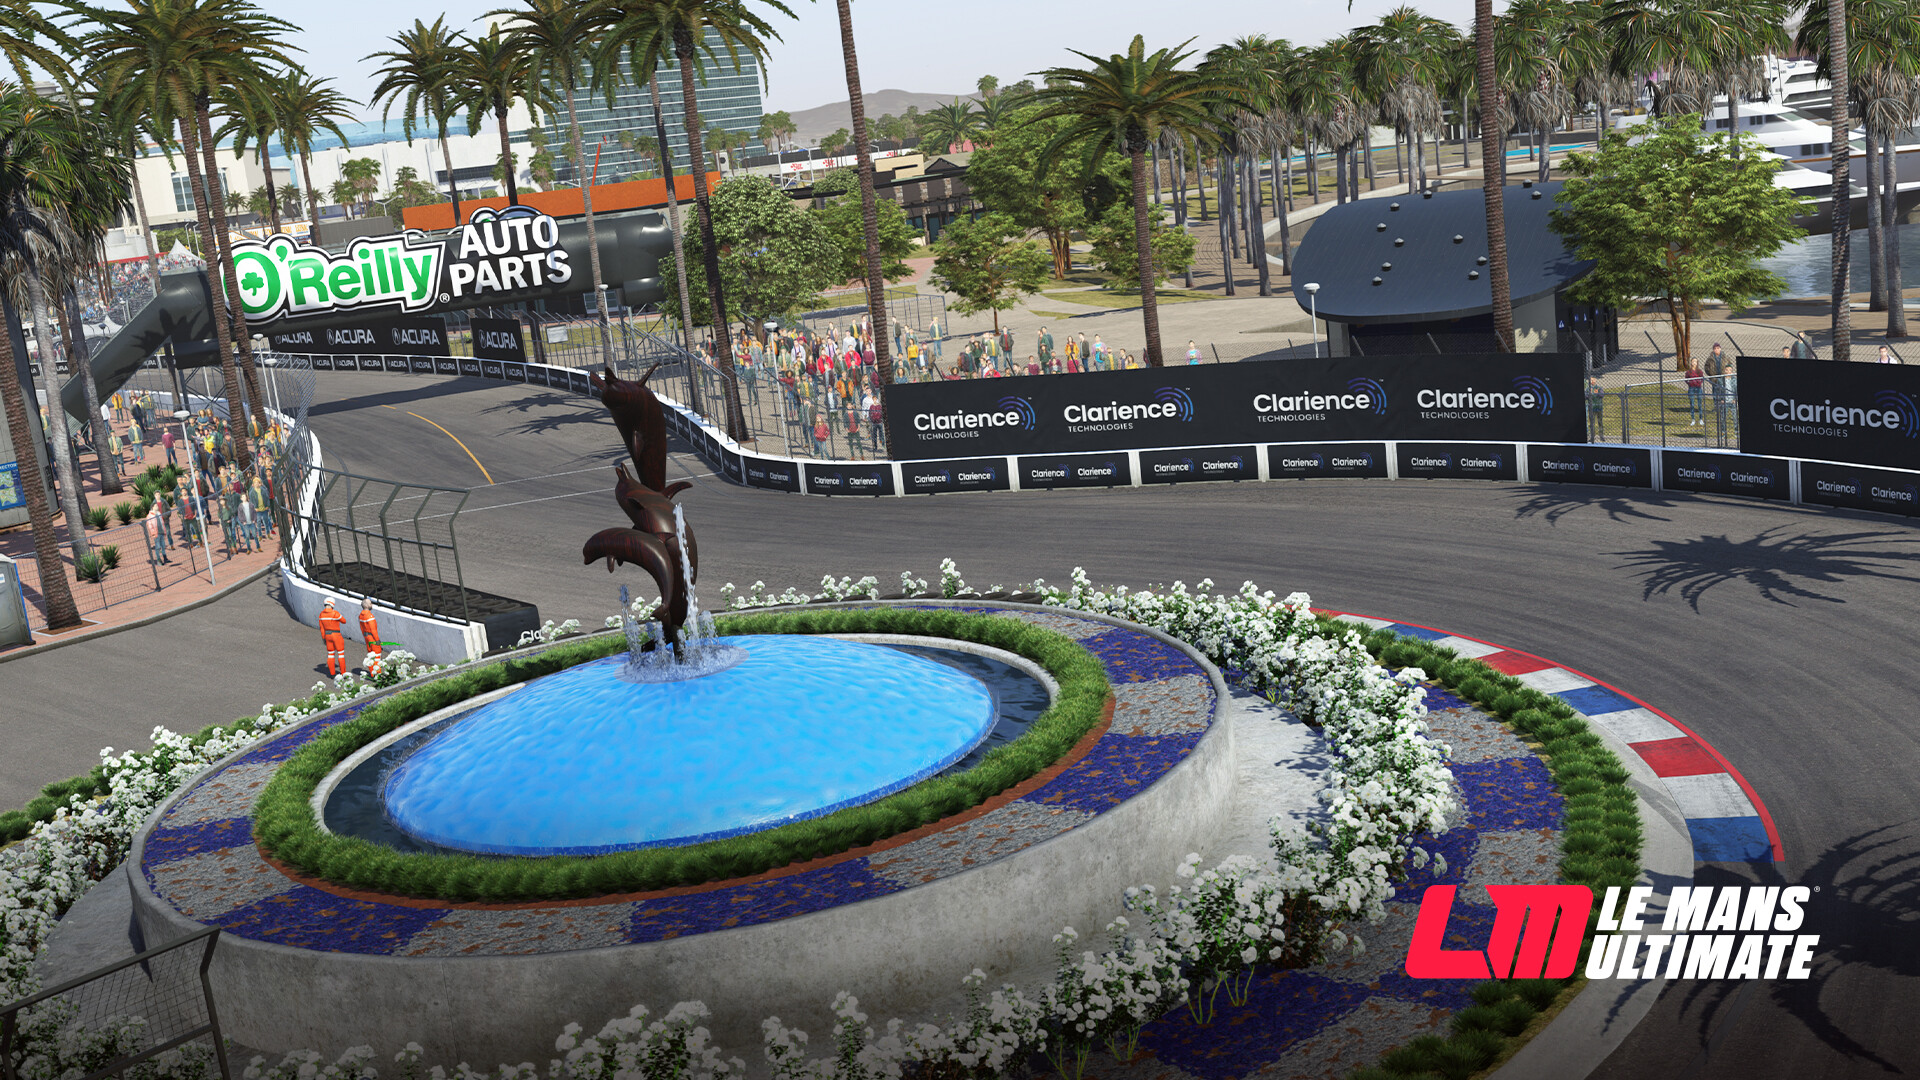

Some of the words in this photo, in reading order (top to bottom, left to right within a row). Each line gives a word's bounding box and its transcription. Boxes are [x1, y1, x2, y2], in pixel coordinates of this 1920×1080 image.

[460, 215, 559, 259] AUTO
[450, 250, 572, 297] PARTS
[223, 246, 434, 314] O'Reilly
[334, 329, 376, 344] ACURA
[401, 328, 440, 345] ACURA
[486, 331, 518, 350] ACURA
[464, 364, 480, 372] ACURA
[1253, 390, 1370, 412] Clarience
[1416, 387, 1536, 410] Clarience
[1064, 401, 1177, 424] Clarience
[1257, 413, 1326, 422] TECHNOLOGIES
[1420, 411, 1490, 419] TECHNOLOGIES
[1770, 398, 1900, 429] Clarience
[914, 410, 1020, 432] Clarience
[1068, 422, 1133, 433] TECHNOLOGIES
[1773, 424, 1848, 438] TECHNOLOGIES
[918, 430, 979, 440] TECHNOLOGIES
[1202, 460, 1238, 470] Clarience
[1282, 458, 1318, 467] Clarience
[1332, 457, 1367, 466] Clarience
[1411, 457, 1447, 466] Clarience
[1460, 458, 1497, 467] Clarience
[1542, 460, 1579, 470] Clarience
[1078, 467, 1112, 476] Clarience
[1154, 463, 1189, 472] Clarience
[1593, 463, 1630, 473] Clarience
[770, 471, 789, 482] Clarience
[914, 474, 946, 483] Clarience
[958, 472, 991, 481] Clarience
[1032, 469, 1065, 478] Clarience
[1678, 468, 1716, 479] Clarience
[1730, 472, 1768, 484] Clarience
[814, 475, 839, 485] Clarience
[850, 476, 878, 486] Clarience
[1817, 480, 1856, 494] Clarience
[1872, 486, 1912, 501] Clarience
